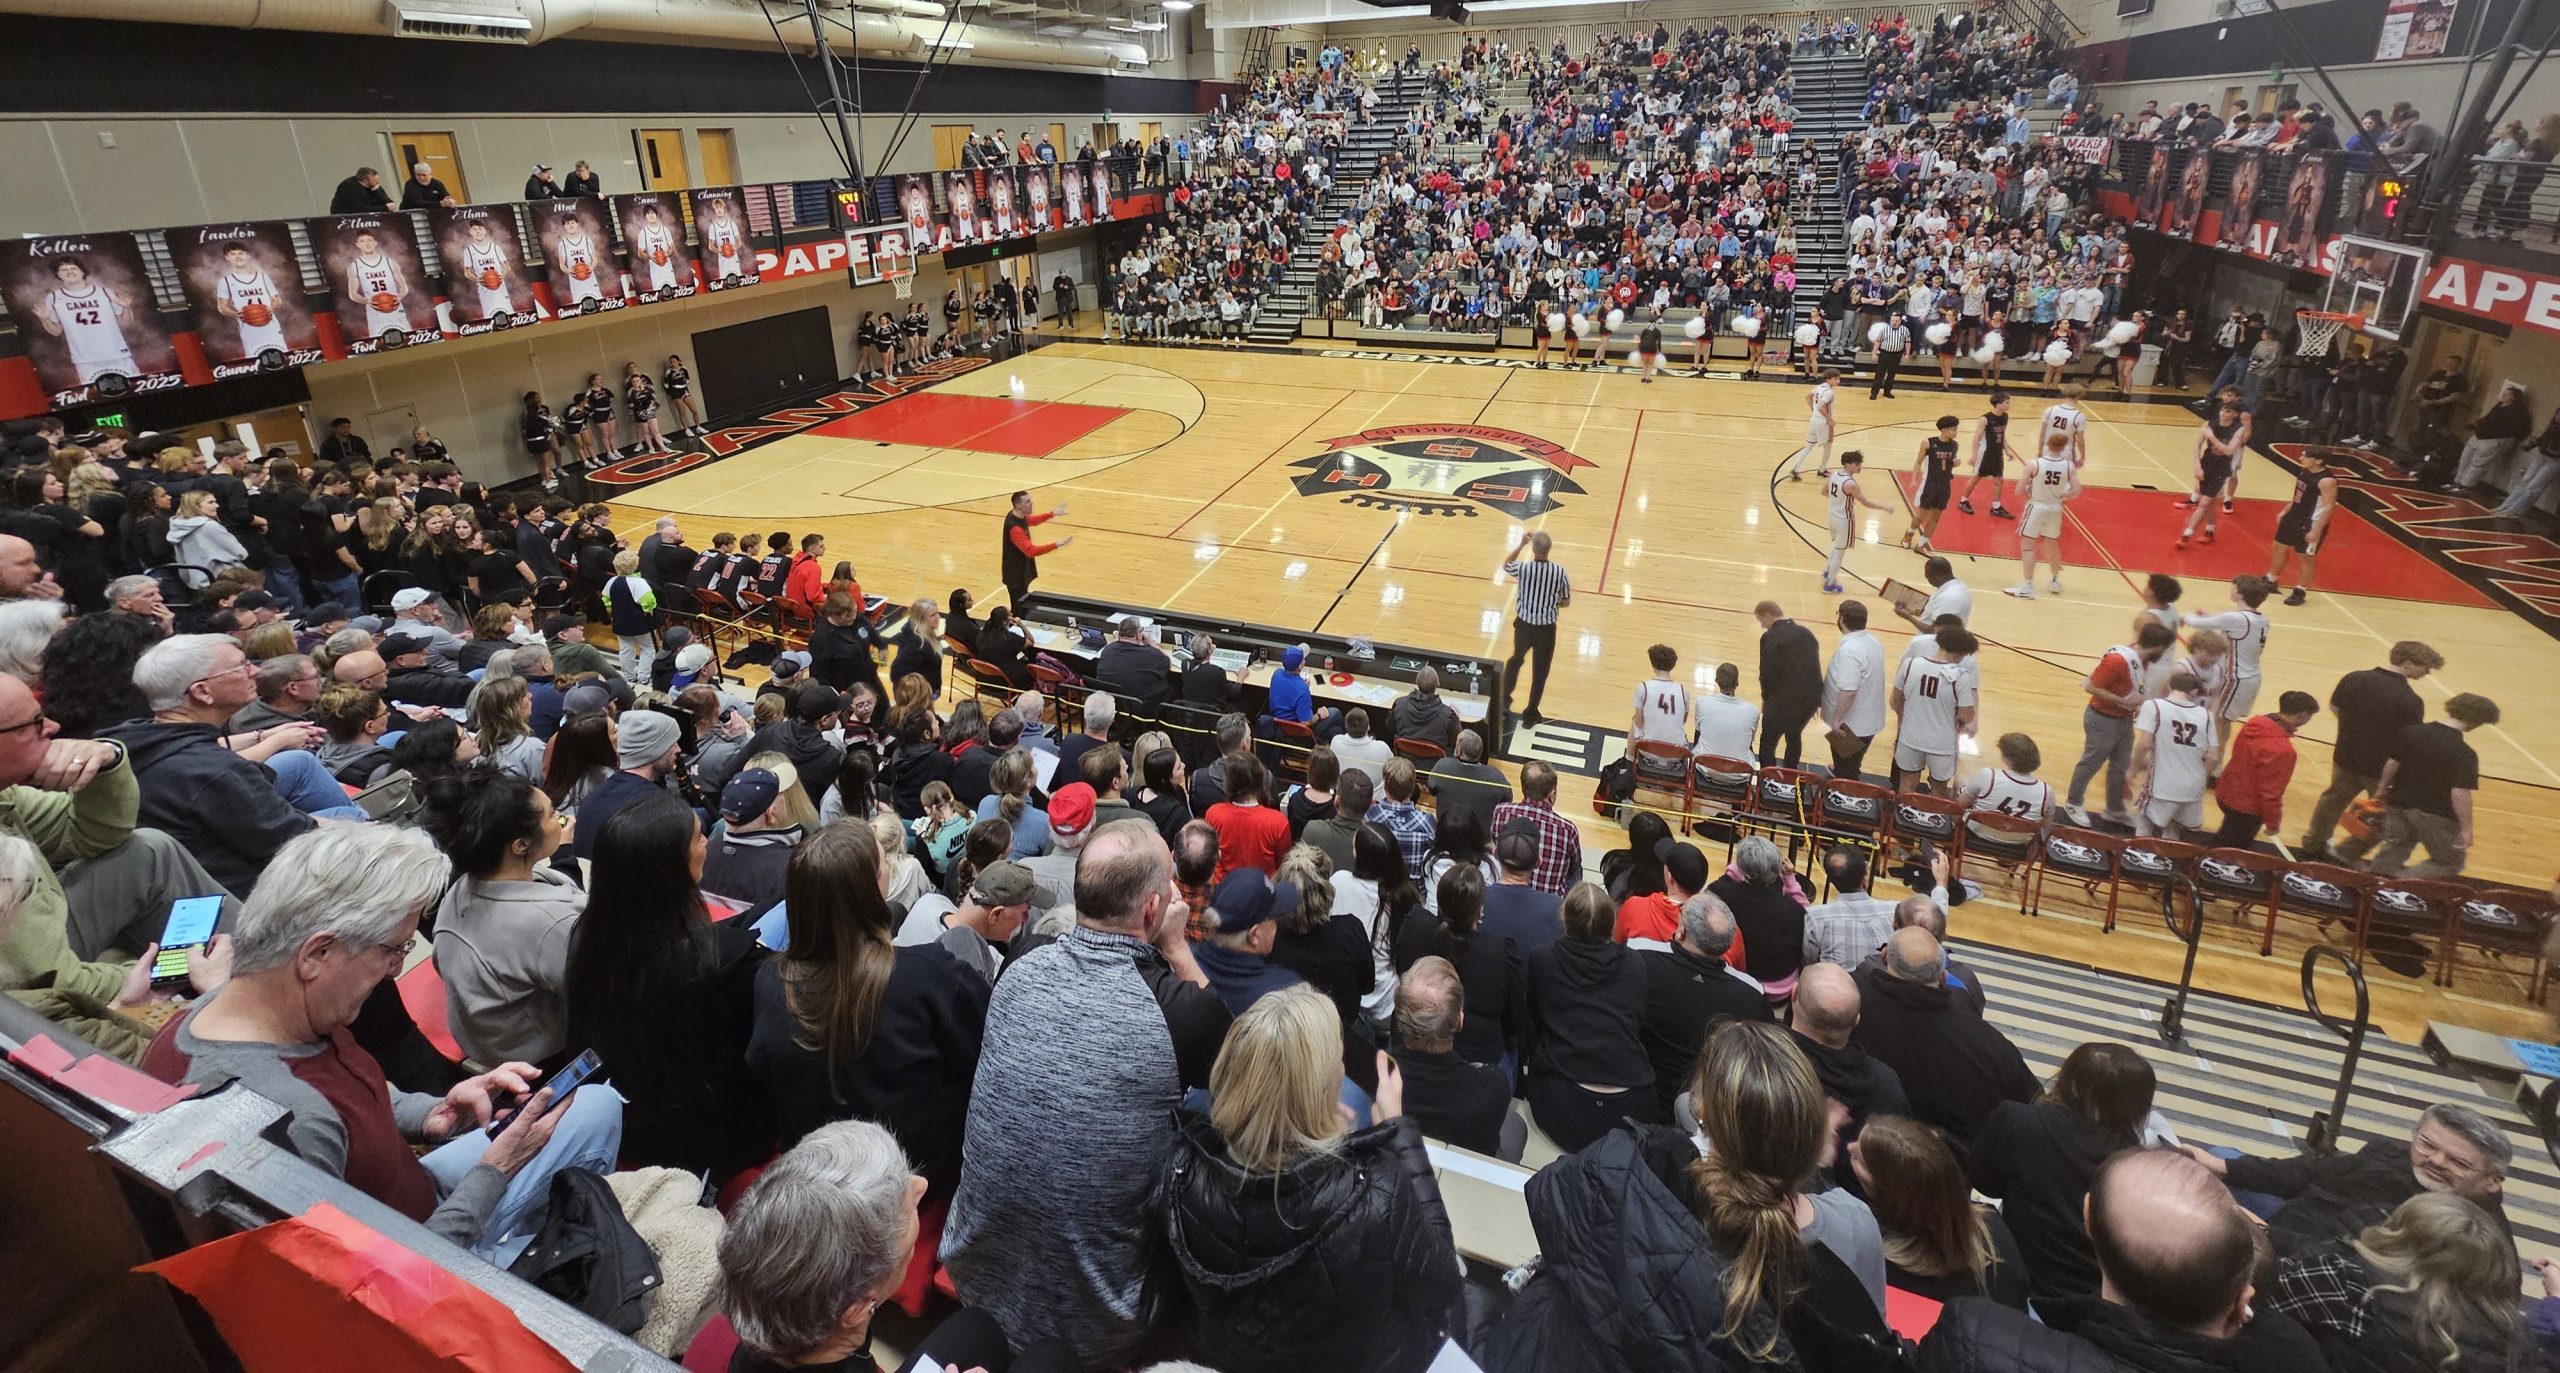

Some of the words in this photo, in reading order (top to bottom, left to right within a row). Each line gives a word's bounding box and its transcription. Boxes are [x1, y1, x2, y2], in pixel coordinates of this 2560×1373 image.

[697, 188, 732, 200] Channing
[846, 203, 858, 223] 9
[337, 217, 381, 230] Ethan
[29, 239, 93, 258] Kellen
[365, 270, 387, 279] CAMAS
[237, 287, 263, 298] CAMAS
[371, 280, 387, 292] 35
[66, 299, 100, 311] CAMAS
[75, 311, 101, 326] 42
[460, 319, 495, 336] Guard
[511, 313, 536, 327] 2026
[352, 339, 377, 355] Fwd
[407, 329, 440, 346] 2026
[212, 358, 261, 379] Guard
[287, 350, 321, 367] 2027
[54, 386, 89, 406] Fwd
[134, 373, 182, 393] 2025
[96, 414, 123, 428] EXIT
[584, 357, 992, 484] CAMAS
[2053, 415, 2068, 431] 20
[2044, 470, 2062, 486] 35
[693, 556, 709, 572] 2
[759, 563, 778, 581] 22
[1919, 674, 1940, 699] 10
[1657, 693, 1676, 715] 41
[2171, 719, 2198, 747] 32
[1996, 796, 2032, 818] 42
